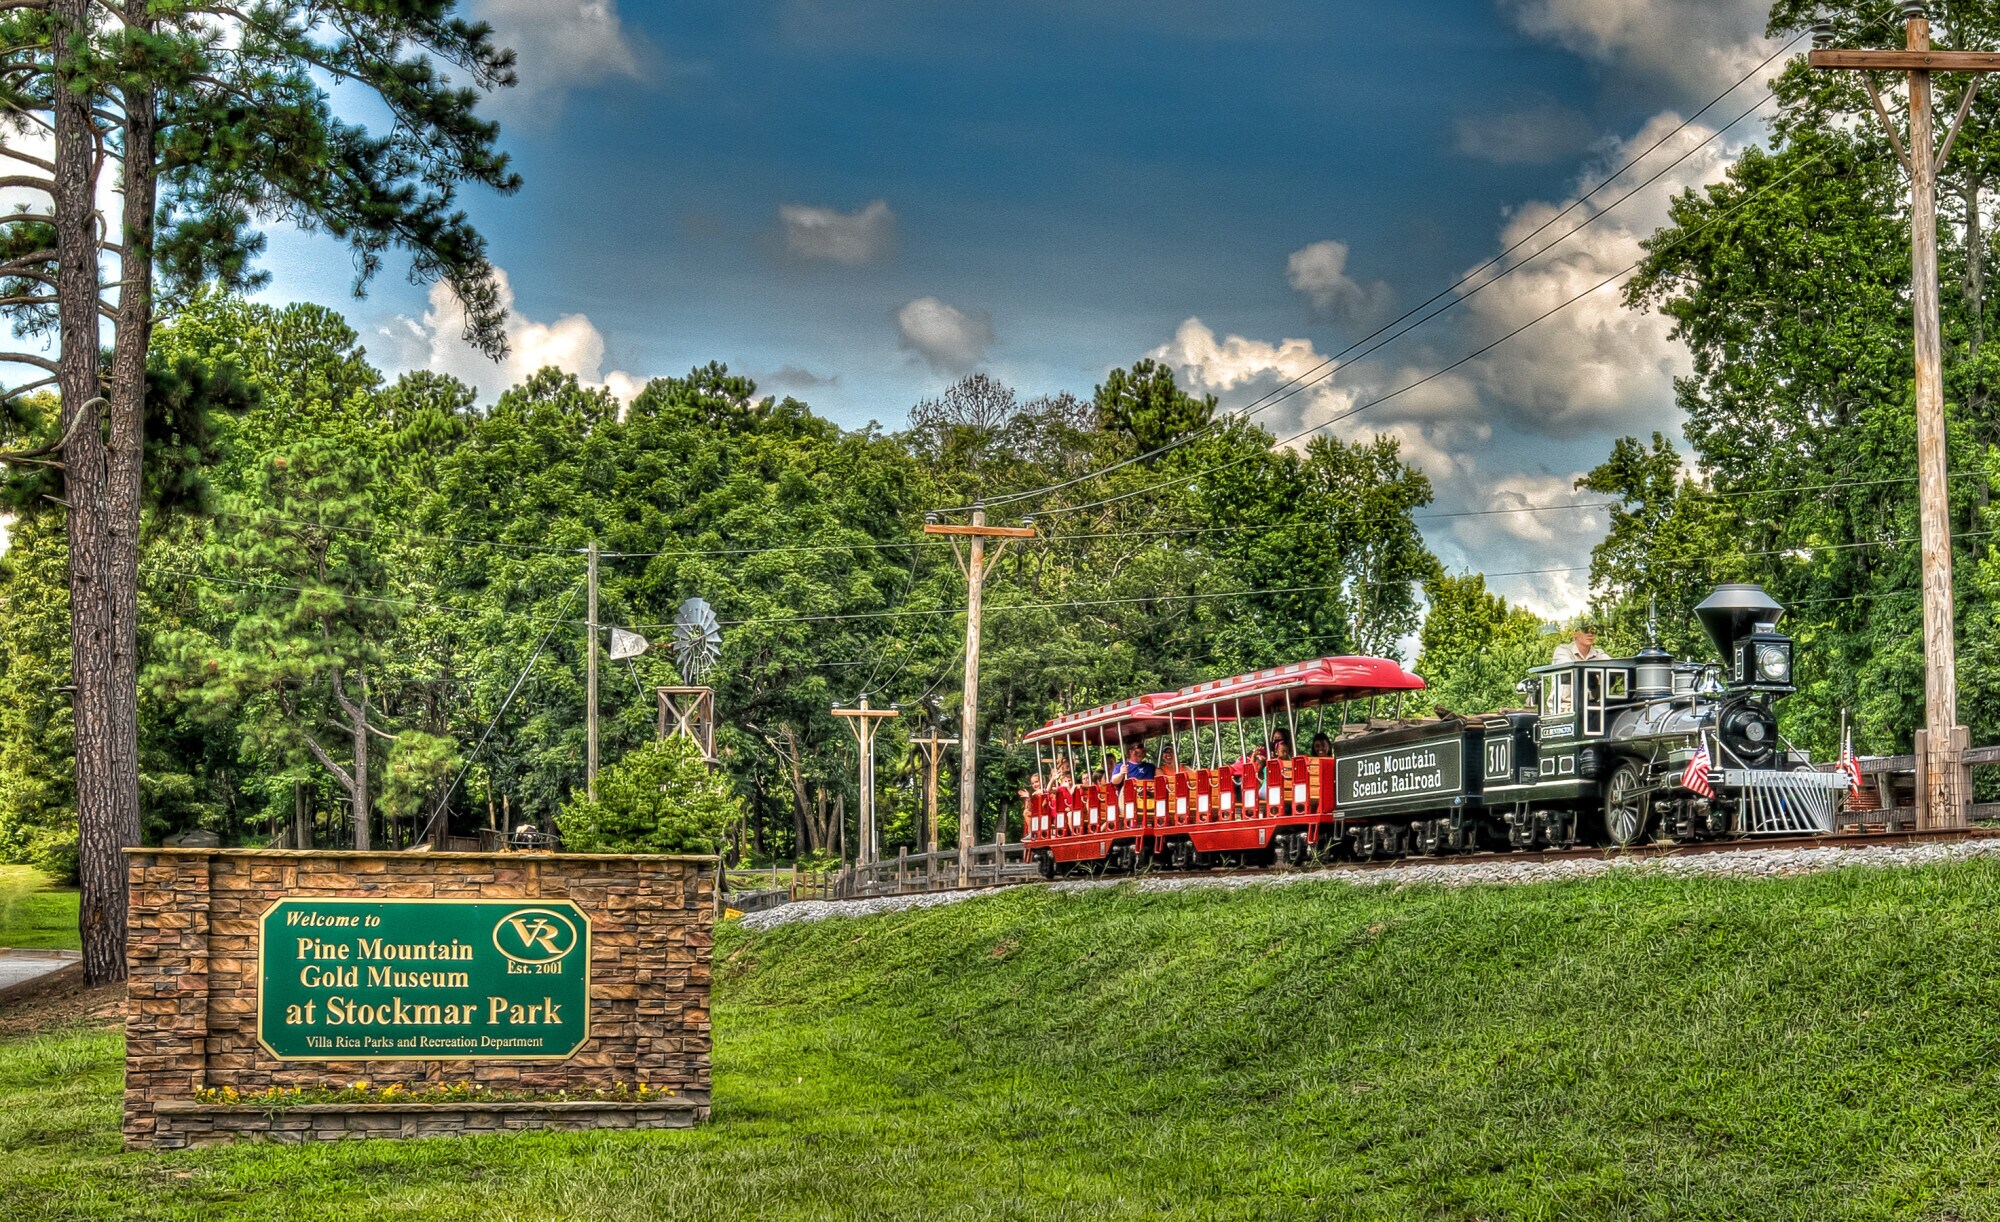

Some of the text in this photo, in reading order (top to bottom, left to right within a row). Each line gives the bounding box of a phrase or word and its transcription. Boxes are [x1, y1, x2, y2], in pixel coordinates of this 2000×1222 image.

[1357, 750, 1436, 778] Pine Mountain
[1489, 744, 1506, 773] 310
[1353, 770, 1442, 798] Scenic Railroad
[287, 912, 380, 926] Welcome to
[297, 938, 473, 960] Pine Mountain
[301, 966, 468, 987] Gold Museum
[508, 959, 561, 973] Est. 2001
[286, 997, 562, 1024] at Stockmar Park
[307, 1036, 542, 1049] Villa Rica Parks and Recreation Department
